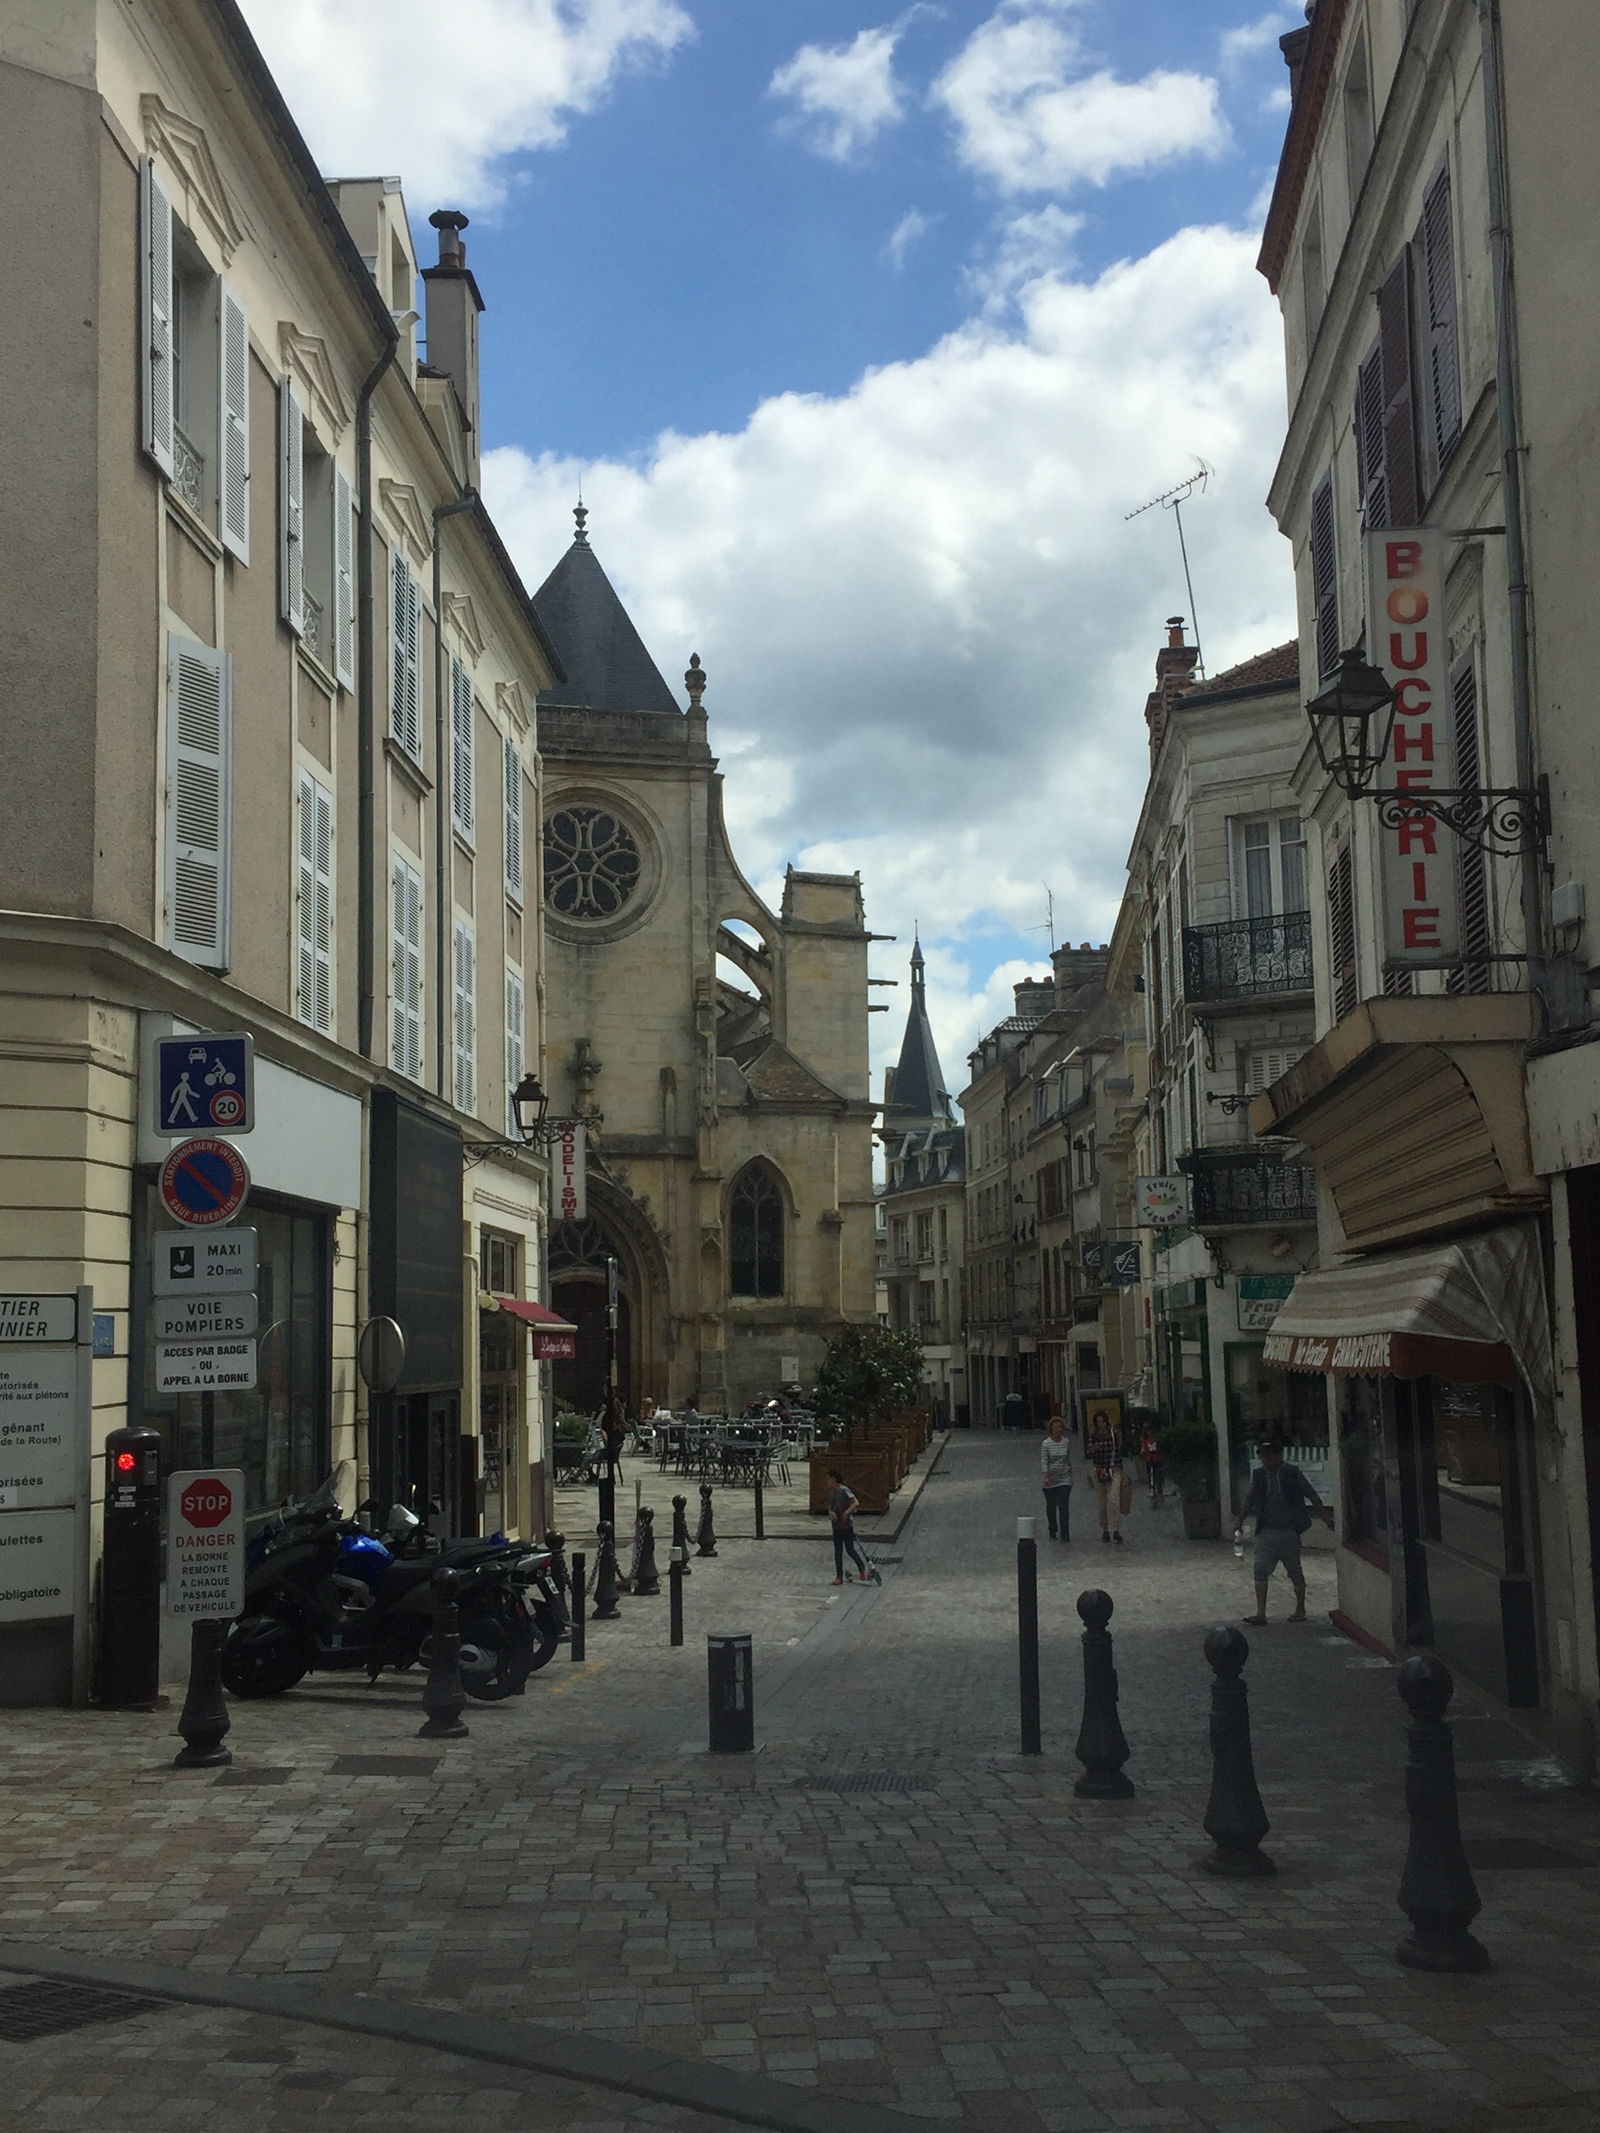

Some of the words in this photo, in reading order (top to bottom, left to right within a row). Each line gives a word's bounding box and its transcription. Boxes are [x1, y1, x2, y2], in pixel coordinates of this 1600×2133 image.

[1385, 541, 1441, 949] BOUCHERIE
[218, 1101, 237, 1115] 20
[164, 1141, 219, 1186] STATIONNEMENT
[219, 1145, 244, 1183] INTERDIT
[559, 1120, 577, 1219] MODELISME
[169, 1198, 191, 1219] SAUF
[192, 1195, 239, 1222] RIVERAINS
[207, 1244, 241, 1256] MAXI
[207, 1265, 224, 1276] 20
[225, 1266, 243, 1276] min
[1, 1300, 40, 1316] TIER
[187, 1301, 222, 1315] VOIE
[1244, 1301, 1285, 1313] Frui
[164, 1317, 244, 1333] POMPIERS
[163, 1347, 193, 1358] ACCES
[196, 1346, 214, 1357] PAR
[217, 1345, 248, 1355] BADGE
[199, 1360, 212, 1370] OU
[163, 1375, 192, 1386] APPEL
[194, 1375, 201, 1384] A
[203, 1374, 215, 1384] LA
[217, 1373, 249, 1383] BORNE
[16, 1392, 33, 1400] aux
[35, 1390, 69, 1401] piétons
[2, 1422, 45, 1436] gênant
[0, 1438, 13, 1446] de
[16, 1437, 25, 1445] la
[28, 1435, 62, 1445] Route)
[184, 1495, 228, 1511] STOP
[176, 1533, 236, 1548] DANGER
[181, 1553, 193, 1562] LA
[196, 1551, 229, 1561] BORNE
[182, 1564, 228, 1575] REMONTE
[180, 1579, 187, 1588] A
[191, 1577, 230, 1587] CHAQUE
[182, 1589, 227, 1600] PASSAGE
[173, 1603, 186, 1613] DE
[188, 1601, 236, 1612] VEHICULE
